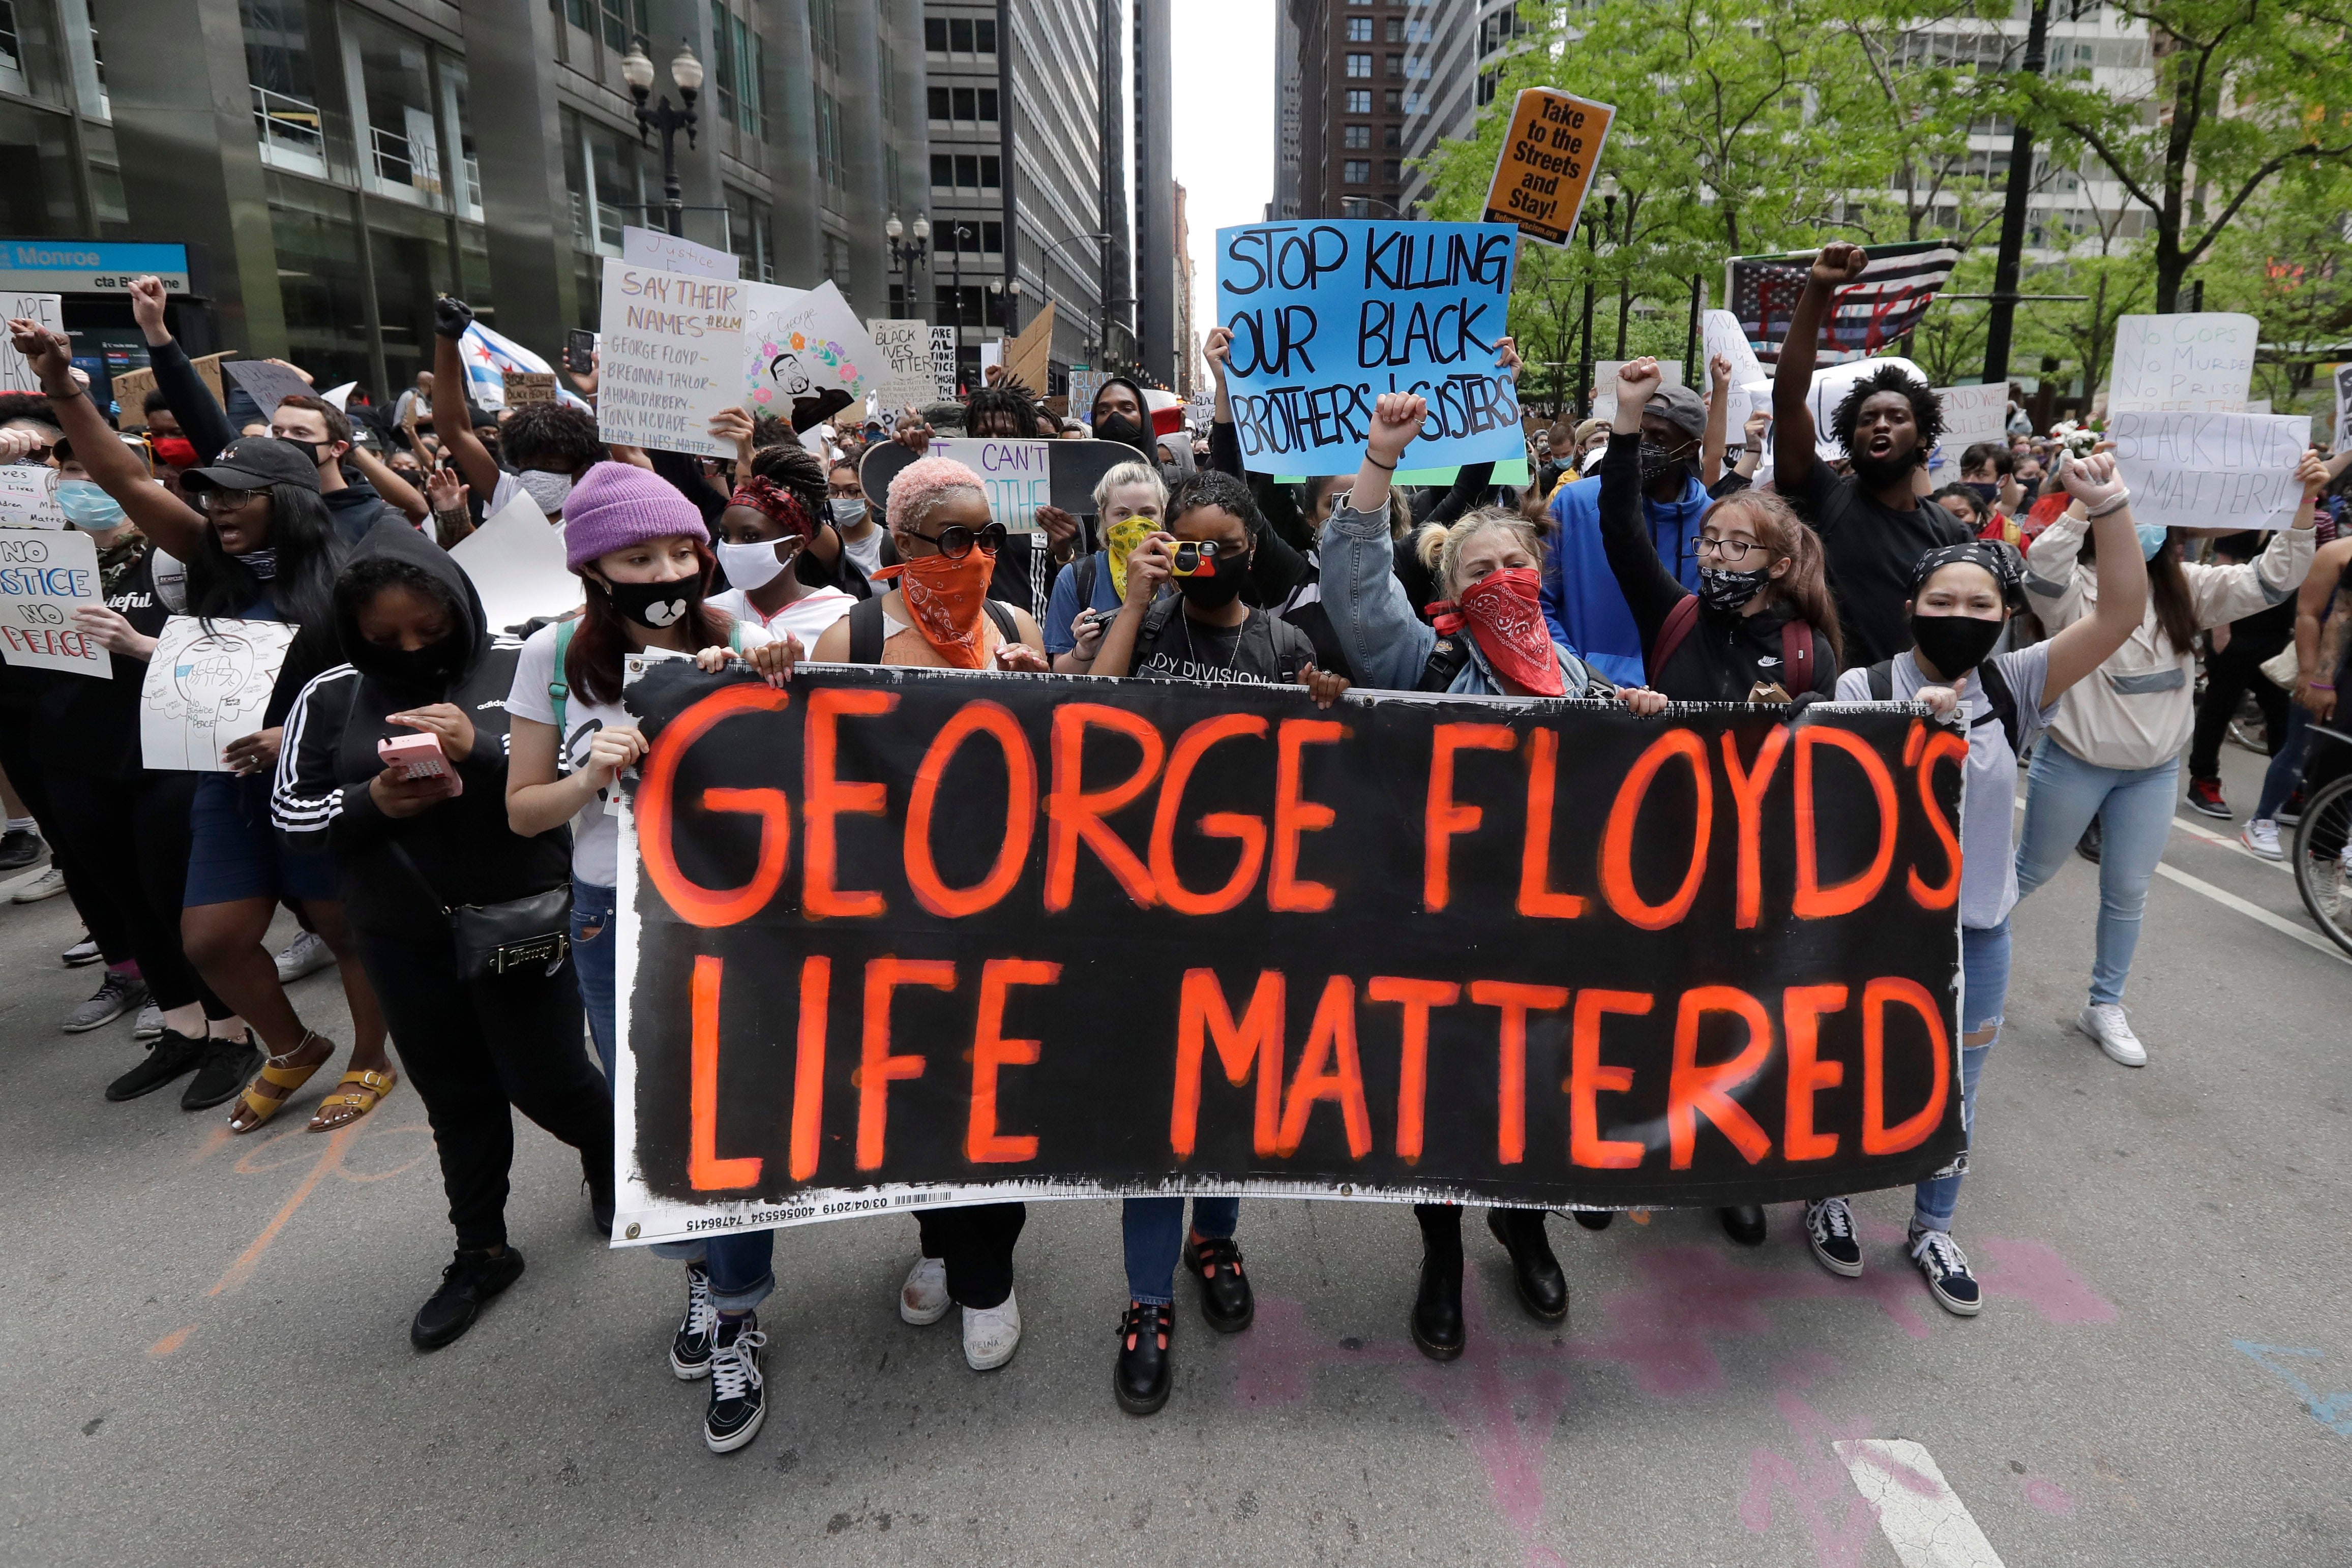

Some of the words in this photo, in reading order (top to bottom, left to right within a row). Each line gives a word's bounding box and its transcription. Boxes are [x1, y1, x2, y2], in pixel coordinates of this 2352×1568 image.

[1541, 97, 1585, 129] Take
[1527, 119, 1546, 142] to
[1551, 127, 1583, 154] the
[1513, 140, 1581, 178] Streets
[1522, 172, 1560, 195] and
[1508, 188, 1558, 220] Stay!
[16, 247, 100, 266] Monroe
[646, 234, 714, 268] Justice
[1222, 226, 1348, 295] STOP
[1364, 227, 1511, 294] KILLING
[95, 277, 115, 287] cta
[621, 272, 671, 304] SAY
[676, 280, 737, 312] THEIR
[627, 306, 705, 338] NAMES
[705, 315, 742, 330] #BLM
[777, 308, 818, 333] George
[876, 329, 915, 346] BLACK
[929, 340, 953, 350] AL
[932, 328, 951, 340] ARE
[1227, 305, 1317, 378] OUR
[1358, 297, 1494, 369] BLACK
[612, 336, 660, 360] GEORGE
[662, 345, 698, 365] FLOYD
[883, 344, 913, 358] IVES
[931, 352, 954, 361] TIONS
[2172, 346, 2250, 370] MURDE
[607, 361, 663, 385] BREONNA
[667, 372, 709, 390] TAYLOR
[887, 355, 934, 374] ATTER
[934, 362, 954, 373] TICE
[938, 386, 952, 395] THE
[1074, 371, 1109, 388] BLACK
[1074, 387, 1098, 402] LIV
[600, 404, 635, 428] TONY
[1075, 402, 1093, 417] MAT
[1197, 408, 1215, 419] LIVE
[1231, 382, 1371, 457] BROTHERS
[1418, 374, 1520, 442] SISTERS
[604, 428, 634, 443] BLACK
[642, 433, 671, 449] LIVES
[675, 438, 716, 454] MATTER
[2115, 413, 2214, 466] BLACK
[2224, 417, 2303, 470] LIVES
[929, 443, 952, 457] I
[982, 443, 1049, 472] CAN'T
[2, 471, 27, 479] ves
[2136, 469, 2289, 515] MATTER!!
[0, 500, 22, 508] dren
[985, 479, 1048, 529] ATHE
[1, 540, 48, 562] NO
[0, 567, 92, 597] STICE
[103, 591, 153, 613] teful
[17, 604, 64, 625] NO
[1, 625, 98, 660] PEACE
[1761, 655, 1778, 664] NIKE
[1183, 660, 1267, 683] DIVISION
[477, 699, 505, 710] adida
[634, 682, 1337, 927] GEORGE
[1423, 718, 1970, 930] FLOYD'S
[687, 955, 1063, 1191] LIFE
[1170, 966, 1951, 1170] MATTERED
[751, 1207, 816, 1224] 400565534
[822, 1197, 888, 1214] 03/04/2019
[686, 1215, 743, 1231] 74786415
